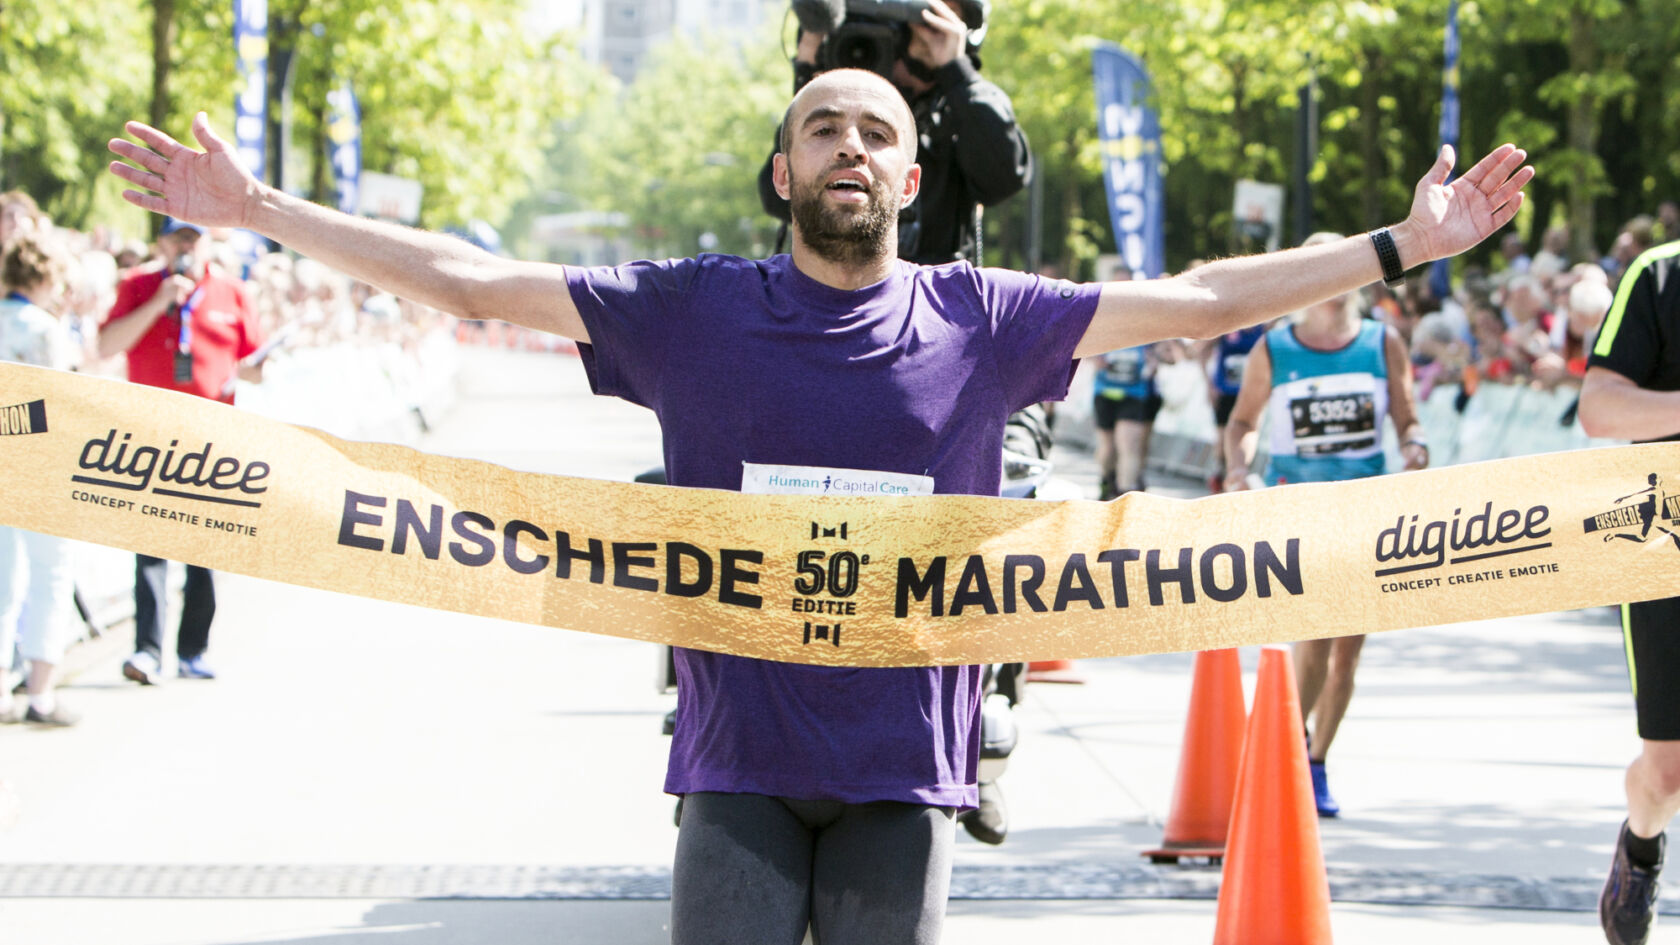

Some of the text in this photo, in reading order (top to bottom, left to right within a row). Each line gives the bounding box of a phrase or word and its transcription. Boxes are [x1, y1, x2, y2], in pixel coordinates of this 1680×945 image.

[78, 429, 271, 494] digidee
[769, 475, 909, 494] Human Capital Care
[71, 490, 258, 537] CONCEPT CREATIE EMOTIE
[1375, 501, 1551, 567] digidee
[1594, 504, 1643, 530] ENSCHEDE
[337, 489, 764, 610] ENSCHEDE
[895, 538, 1304, 618] MARATHON
[1381, 563, 1559, 594] CONCEPT CREATIE EMOTIE
[792, 598, 856, 615] EDITIE
